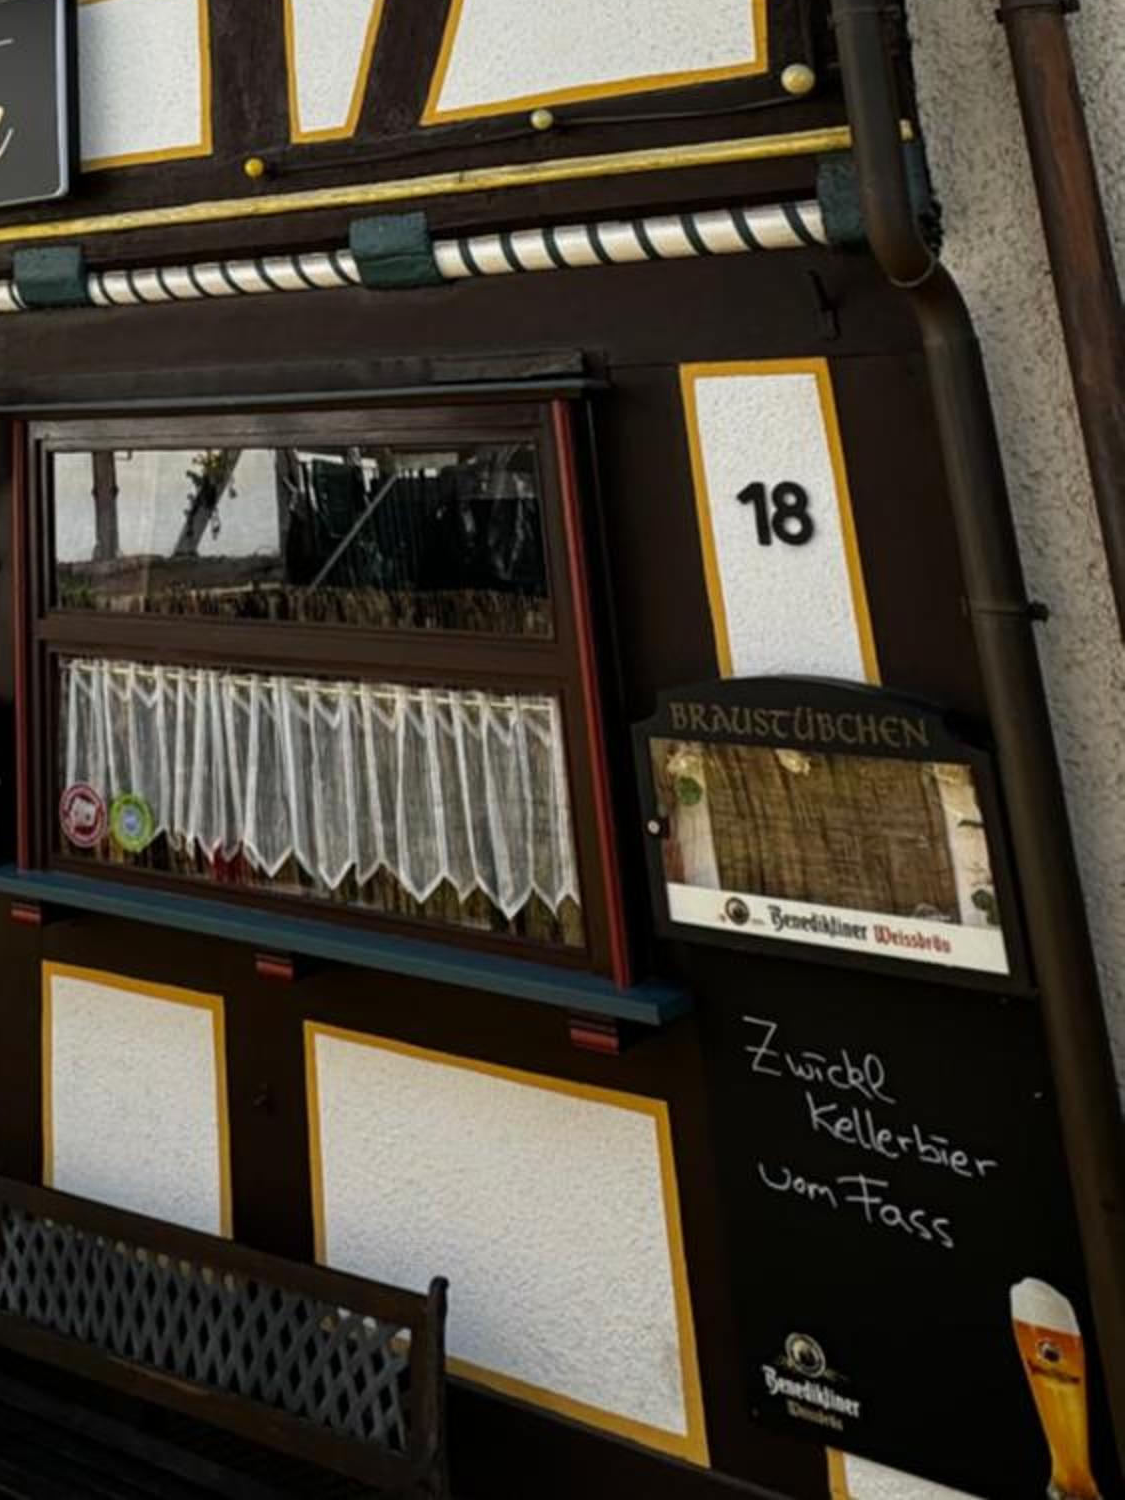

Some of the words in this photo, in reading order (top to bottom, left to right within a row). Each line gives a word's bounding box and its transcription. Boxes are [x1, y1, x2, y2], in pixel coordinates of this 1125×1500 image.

[736, 481, 815, 547] 18
[669, 702, 930, 749] BRAUSTÜBCHEN
[806, 1091, 998, 1178] Kellerbier
[837, 1174, 954, 1249] Fass
